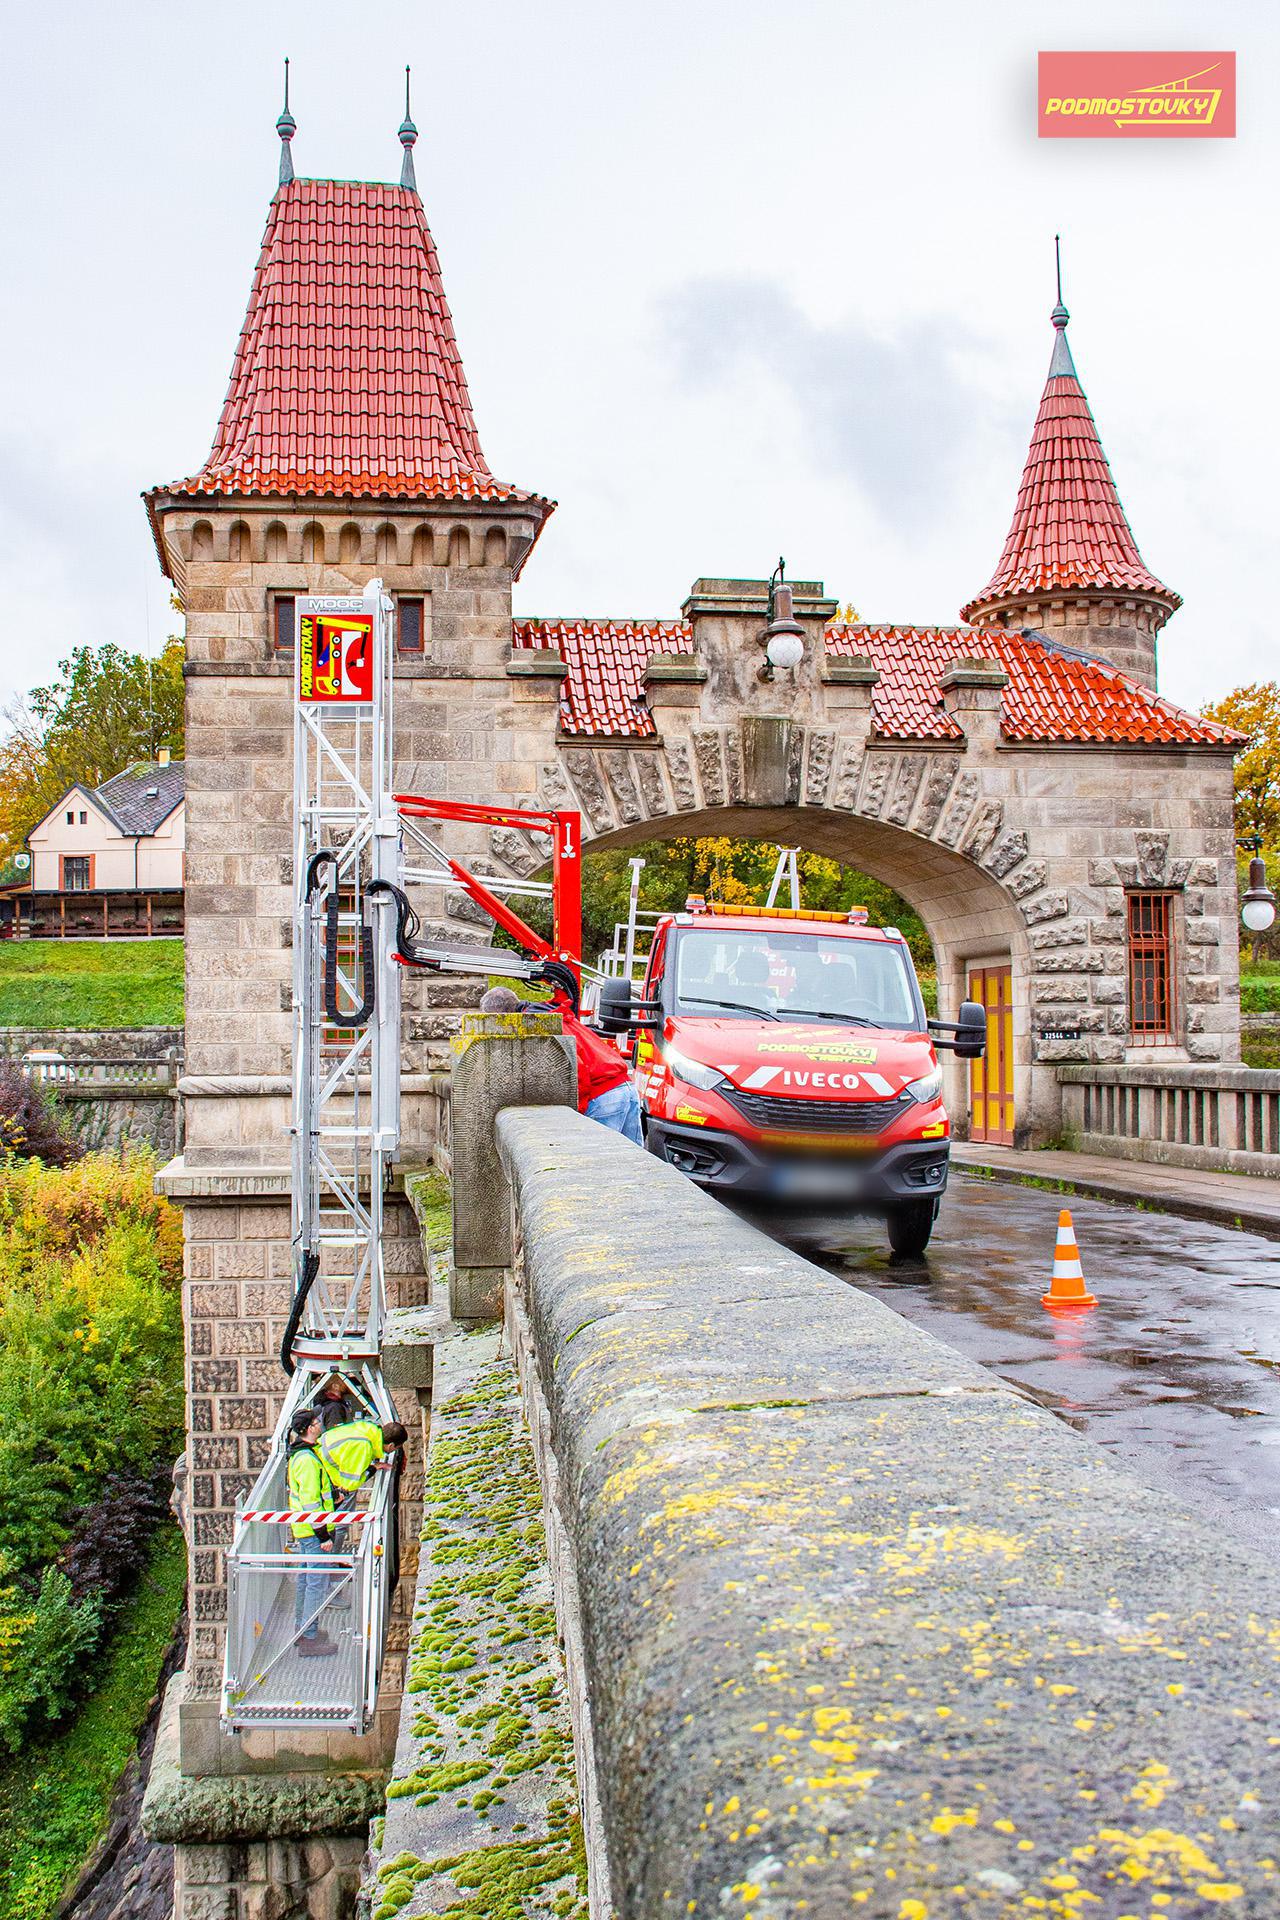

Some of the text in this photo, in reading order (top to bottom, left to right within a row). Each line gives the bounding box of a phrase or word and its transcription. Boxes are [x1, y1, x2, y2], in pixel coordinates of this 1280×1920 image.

[301, 617, 313, 698] PODMOSTOVKY
[757, 1043, 872, 1057] PODMOSTOVKY
[783, 1071, 860, 1090] IVECO
